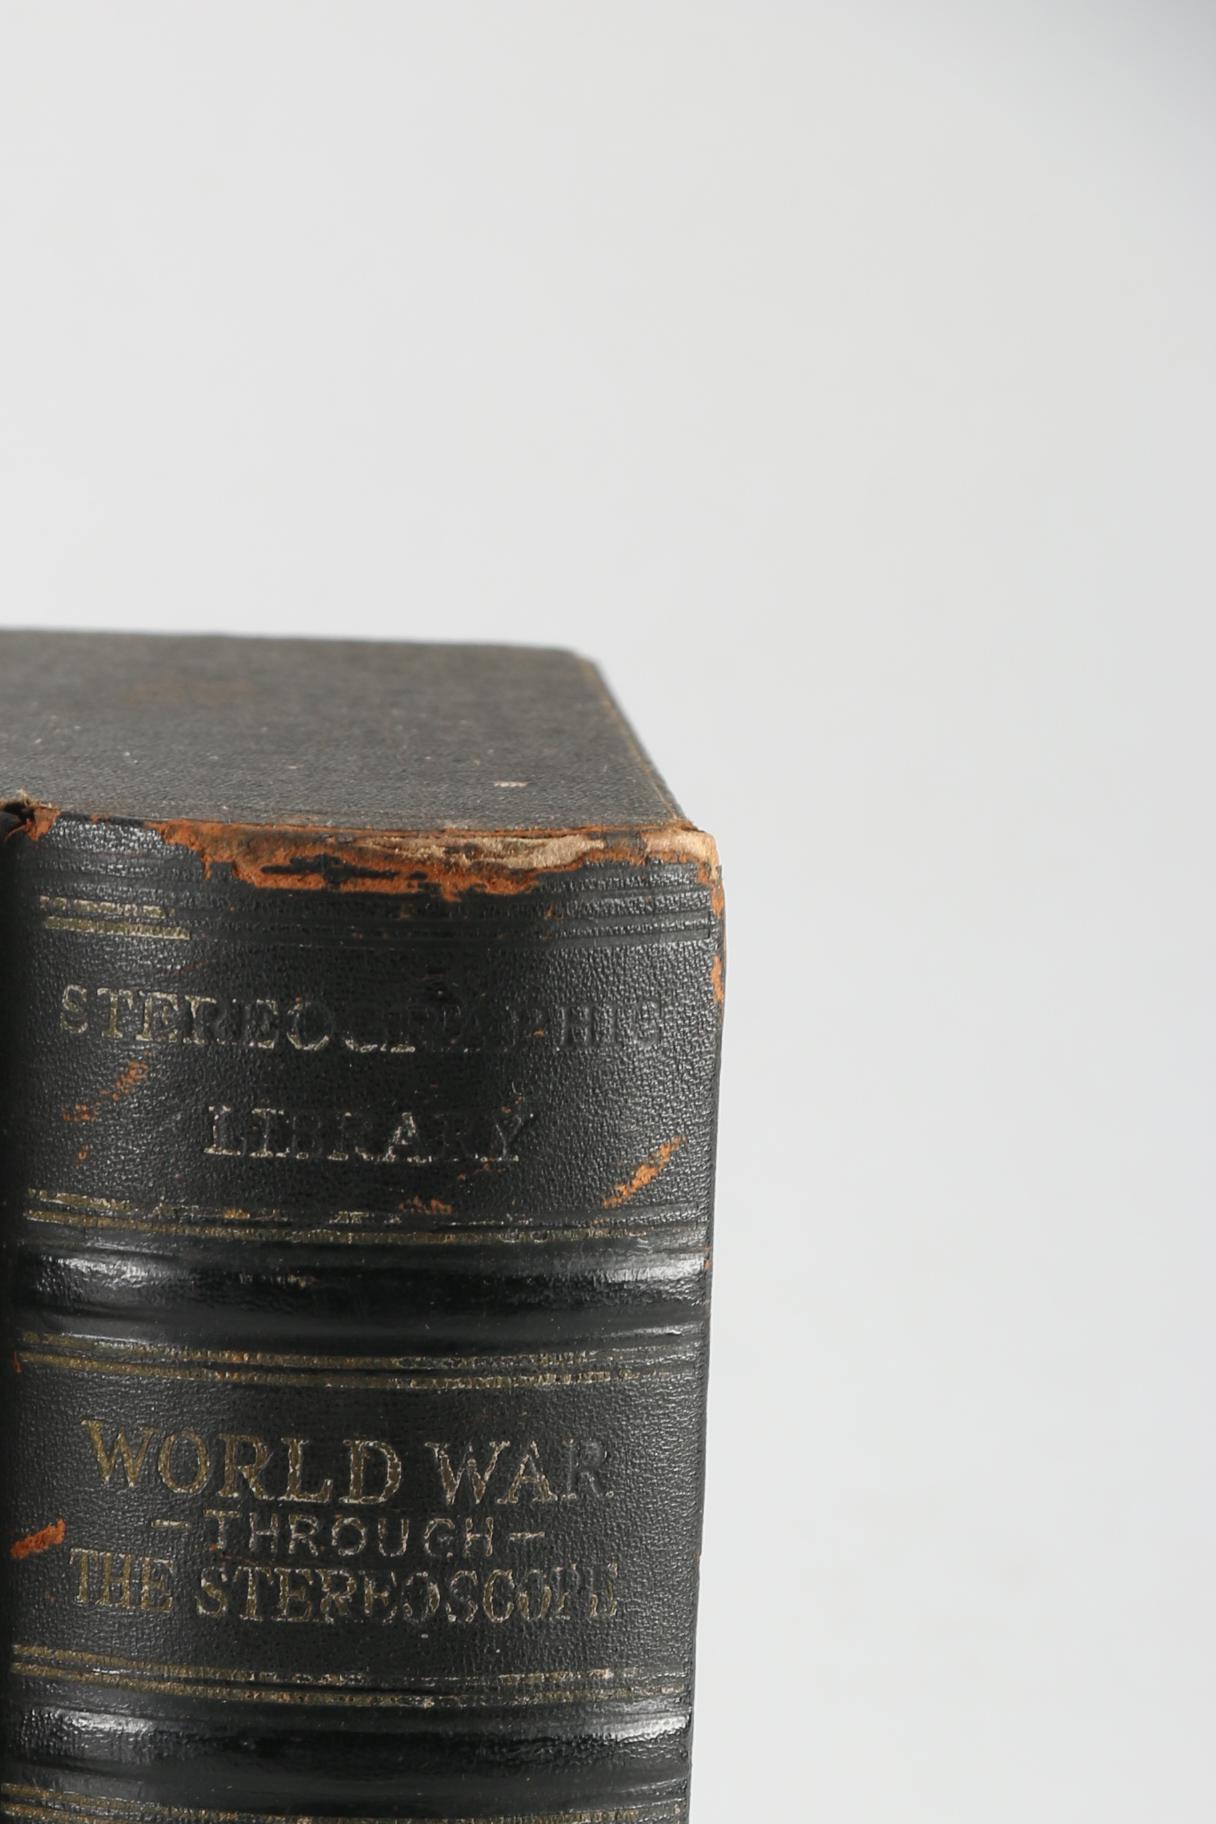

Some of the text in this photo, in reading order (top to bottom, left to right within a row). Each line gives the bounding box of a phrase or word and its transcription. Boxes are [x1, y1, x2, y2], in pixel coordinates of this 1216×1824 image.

[59, 983, 659, 1053] STEREOPHIC
[81, 1418, 616, 1505] WORLD WAR
[68, 1547, 620, 1625] THE STEREOSCOPE
